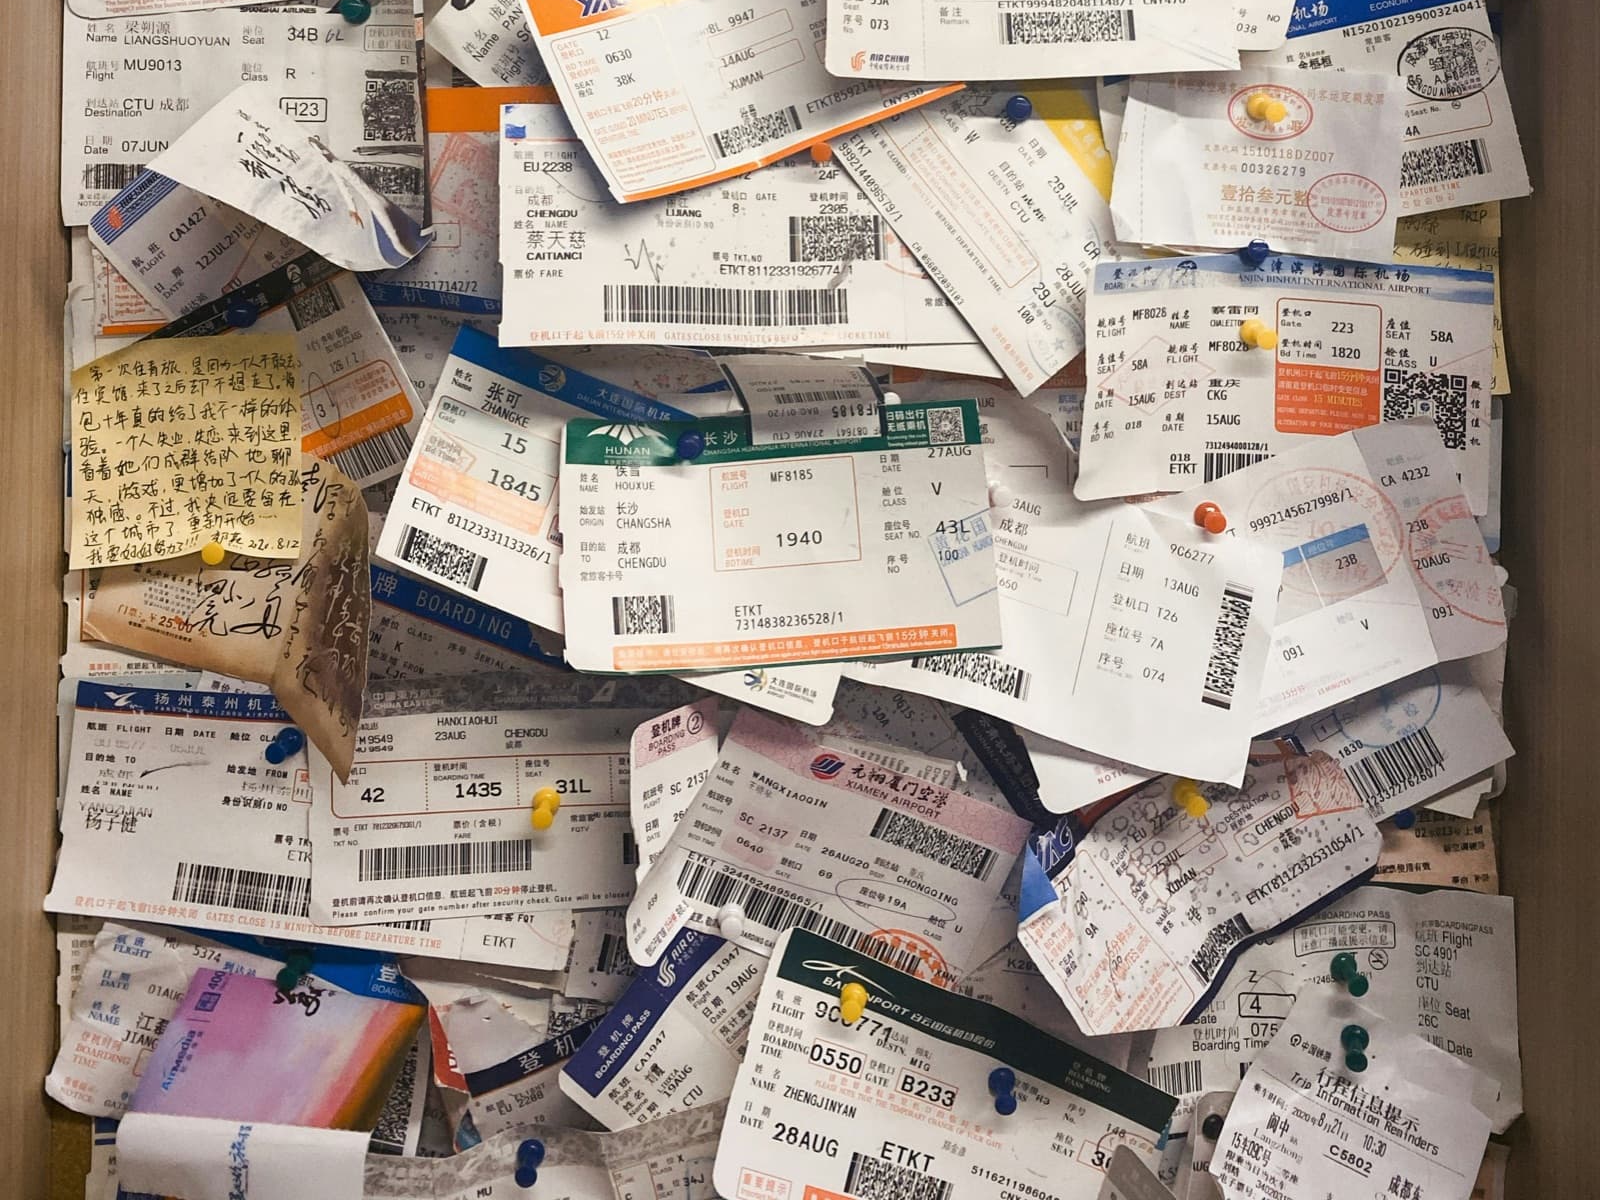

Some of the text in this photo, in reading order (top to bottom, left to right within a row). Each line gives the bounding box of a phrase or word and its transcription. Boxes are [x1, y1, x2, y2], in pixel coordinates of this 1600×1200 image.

[870, 18, 890, 32] 073
[124, 34, 231, 47] LIANGSHUOYUAN
[287, 26, 319, 41] 34B
[605, 48, 633, 65] 0630
[124, 58, 182, 73] MU9013
[123, 98, 190, 112] CTU 成都
[285, 101, 320, 117] H23
[523, 161, 574, 174] EU 2238
[818, 169, 839, 181] 24F
[526, 208, 578, 219] CHENGDU
[526, 231, 586, 250] 蔡天慈
[526, 250, 583, 261] CAITIANCI
[1331, 321, 1354, 335] 223
[1430, 330, 1454, 344] 58A
[1331, 346, 1361, 360] 1820
[1207, 389, 1228, 401] CKG
[481, 400, 531, 427] ZHANGKE
[1207, 414, 1241, 426] 15AUG
[500, 432, 528, 455] 15
[605, 445, 650, 457] HUNAN
[927, 445, 972, 459] 27AUG
[770, 468, 813, 482] MF8185
[1169, 463, 1198, 474] ETKT
[1380, 466, 1430, 487] CA 4232
[487, 467, 542, 502] 1845
[615, 480, 656, 491] HOUXUE
[616, 517, 672, 530] CHANGSHA
[776, 529, 823, 547] 1940
[1169, 543, 1215, 566] 9C6277
[1414, 553, 1451, 571] 20AUG
[617, 557, 667, 569] CHENGDU
[1163, 577, 1200, 598] 13AUG
[734, 605, 763, 618] ETKT
[1156, 607, 1178, 624] T26
[1142, 667, 1166, 683] 074
[436, 715, 498, 728] HANXIAOHUI
[455, 782, 503, 799] 1435
[555, 779, 591, 794] 31L
[752, 772, 829, 809] WANGXIAOQIN
[360, 787, 385, 804] 42
[845, 780, 942, 821] XIAMEN AIRPORT
[739, 812, 789, 840] SC 2137
[483, 934, 516, 949] ETKT
[1414, 946, 1458, 959] SC 4901
[1415, 976, 1439, 991] CTU
[809, 1044, 863, 1076] 0550
[901, 1074, 956, 1108] B233
[783, 1085, 857, 1120] ZHENGJINYAN
[771, 1122, 839, 1158] 28AUG
[880, 1141, 935, 1172] ETKT
[1329, 1144, 1374, 1172] C5802
